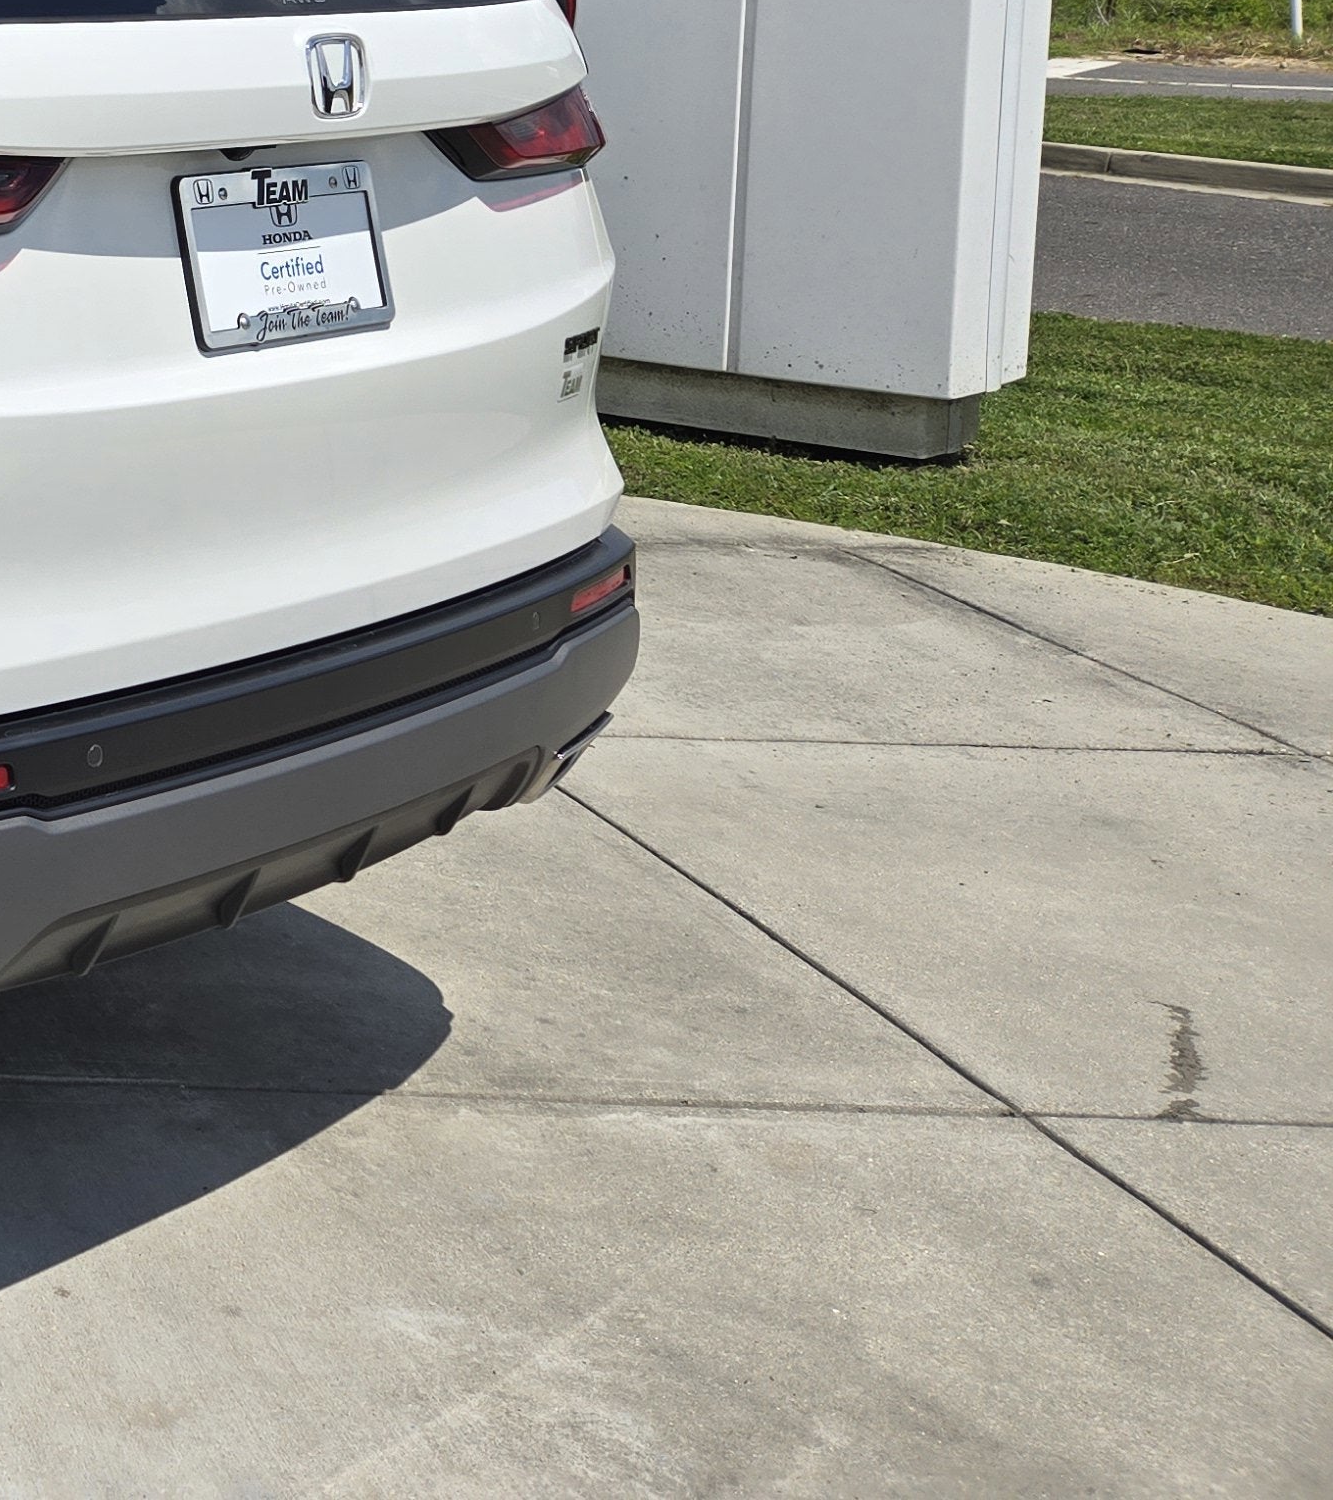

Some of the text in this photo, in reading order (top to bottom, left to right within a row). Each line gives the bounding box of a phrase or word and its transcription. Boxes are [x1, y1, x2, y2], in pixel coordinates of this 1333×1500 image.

[251, 169, 309, 206] TEAM
[262, 230, 313, 246] HONDA
[260, 254, 325, 281] Certified
[264, 277, 327, 295] Pre-Owned
[256, 311, 287, 342] Join
